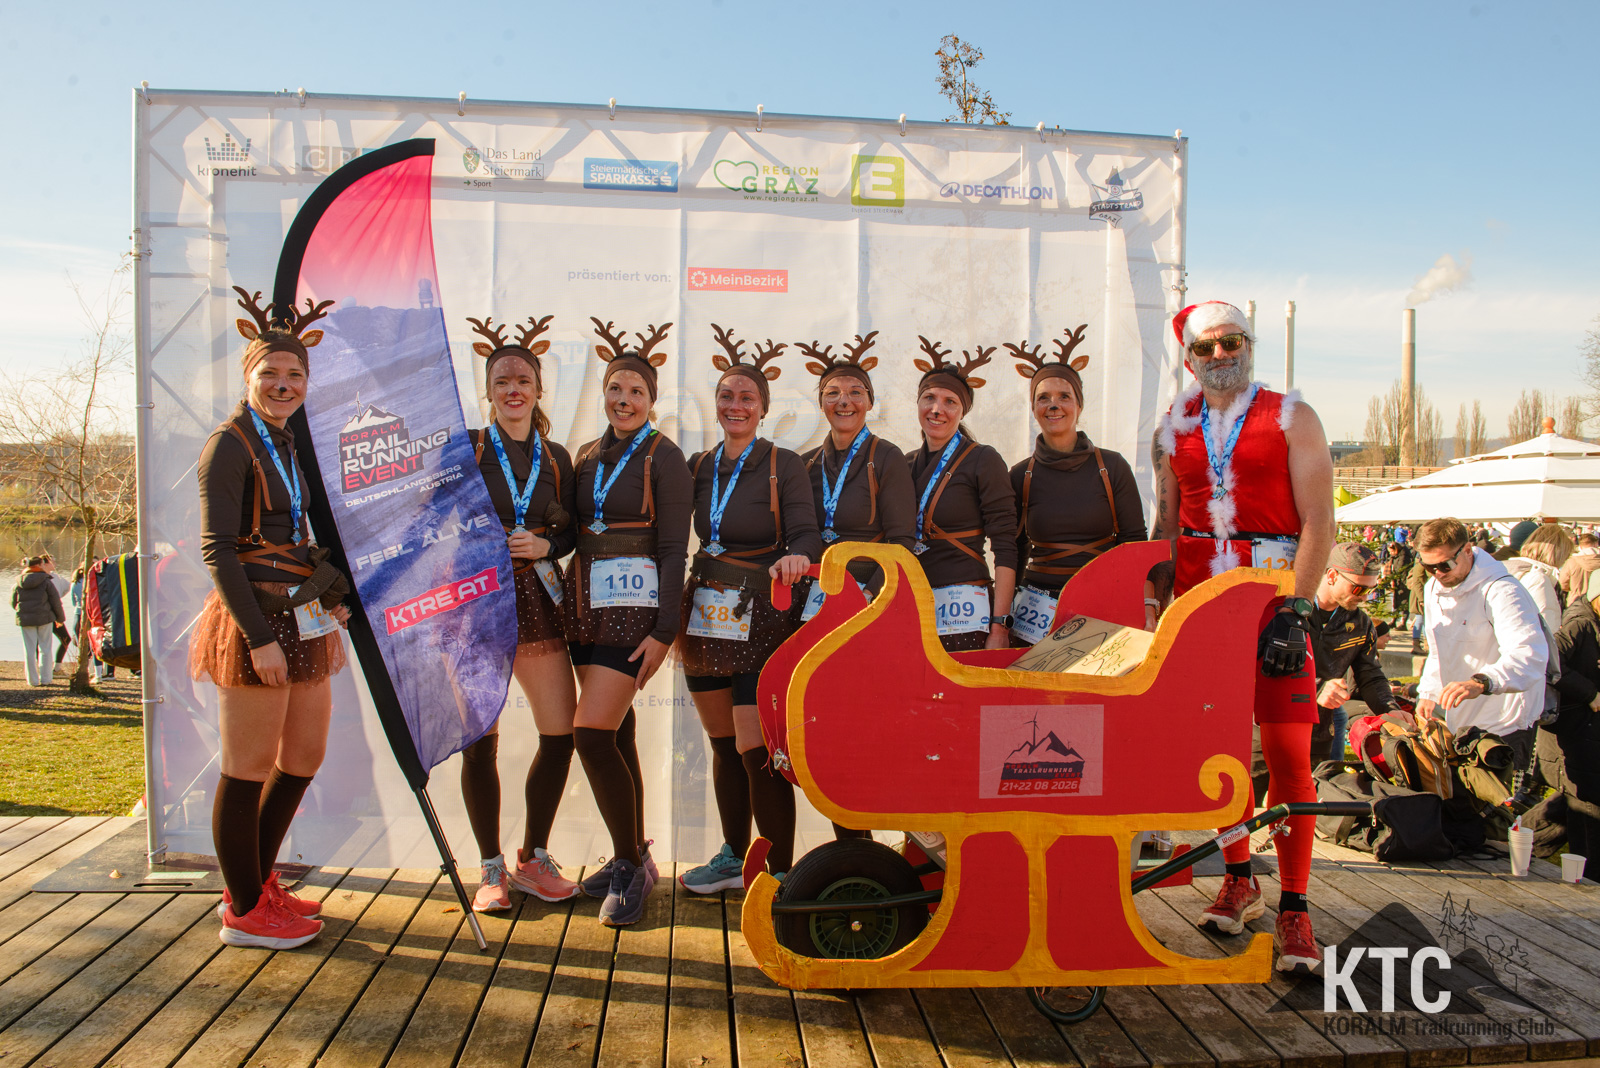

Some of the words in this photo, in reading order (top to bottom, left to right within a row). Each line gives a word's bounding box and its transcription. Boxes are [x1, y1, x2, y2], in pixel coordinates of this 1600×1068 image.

[486, 147, 508, 160] Das
[512, 148, 541, 161] Land
[197, 165, 257, 177] kronehit
[482, 164, 542, 177] Steiermark
[590, 164, 659, 175] Steiermärkische
[762, 165, 819, 177] REGION
[473, 179, 492, 188] Sport
[590, 172, 659, 186] SPARKASSE
[742, 175, 818, 195] GRAZ
[743, 195, 818, 203] www.regiongraz.at
[963, 184, 1053, 200] DECATHLON
[567, 268, 641, 282] präsentiert
[644, 274, 672, 283] von:
[710, 273, 785, 287] MeinBezirk
[341, 422, 401, 444] KORALM
[342, 433, 408, 459] TRAIL
[343, 430, 449, 475] RUNNING
[344, 454, 420, 490] EVENT
[345, 464, 462, 508] DEUTSCHLANDSBERG
[419, 472, 464, 493] AUSTRIA
[355, 543, 415, 571] FEEL
[422, 513, 491, 548] ALIVE
[1262, 556, 1294, 570] 12
[604, 573, 644, 590] 110
[607, 590, 641, 598] Jennifer
[938, 601, 975, 618] 109
[1017, 605, 1050, 630] 223
[648, 695, 686, 707] Event
[1001, 781, 1032, 791] 21+22
[1034, 781, 1049, 790] 08
[1051, 780, 1078, 790] 2026
